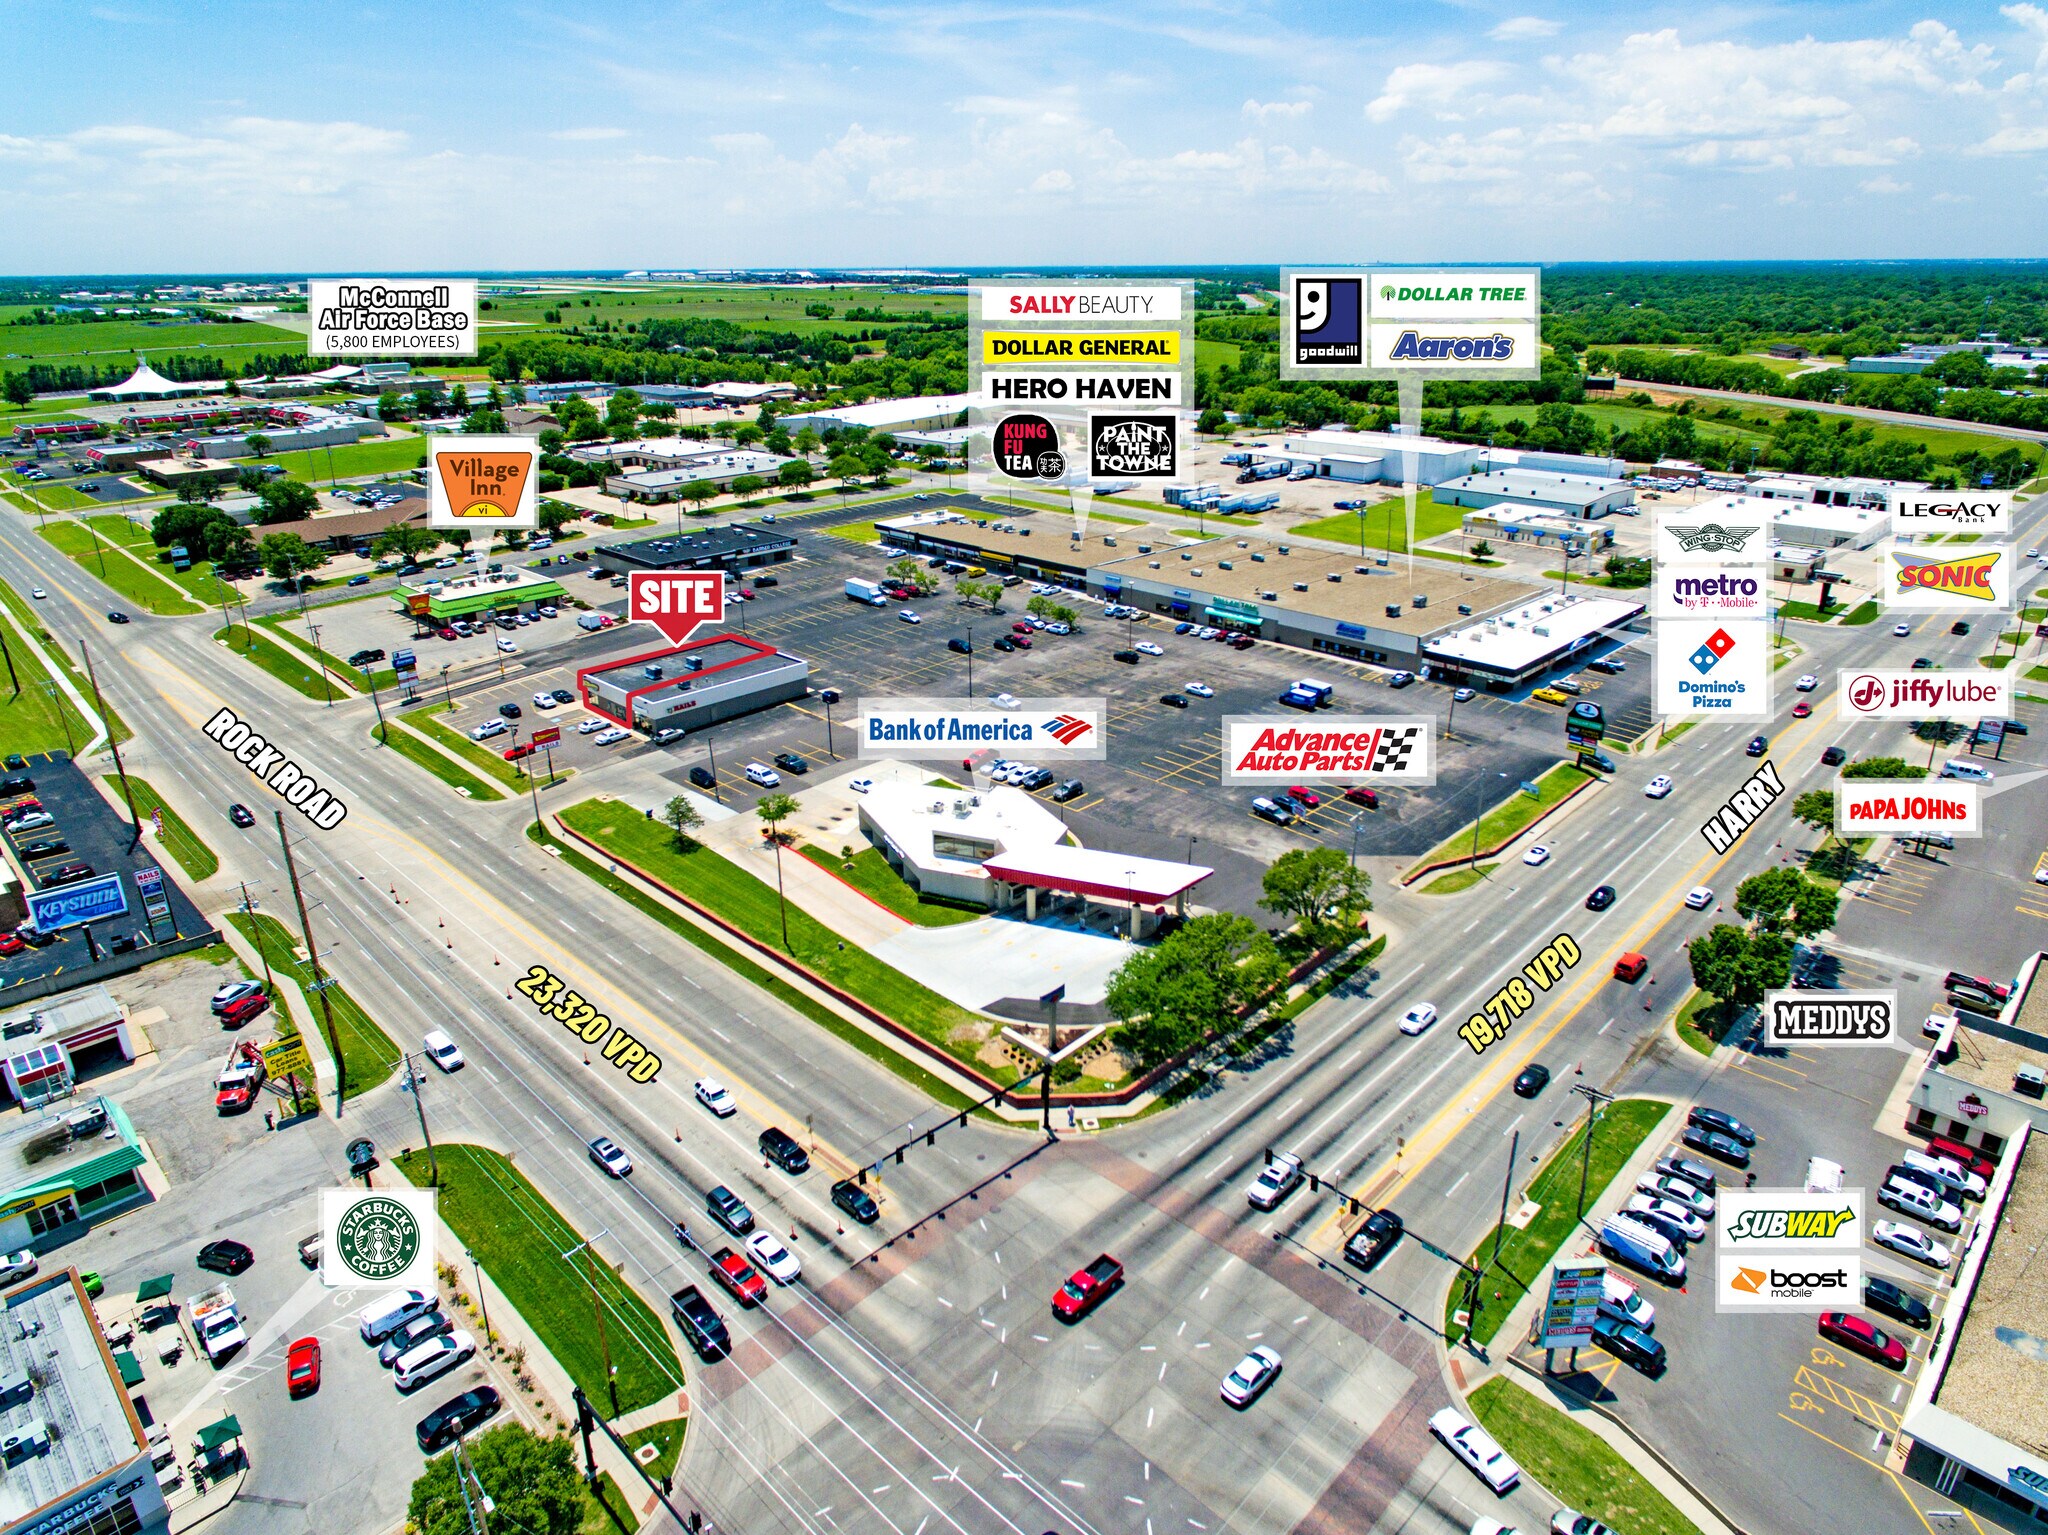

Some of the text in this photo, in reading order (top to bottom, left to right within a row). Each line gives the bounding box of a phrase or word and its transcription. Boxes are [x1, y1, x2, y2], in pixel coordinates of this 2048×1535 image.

[673, 700, 697, 712] NAILS
[137, 869, 160, 881] NAILS
[37, 885, 120, 921] KEYSTONE
[1959, 1102, 1987, 1115] MEDDYS
